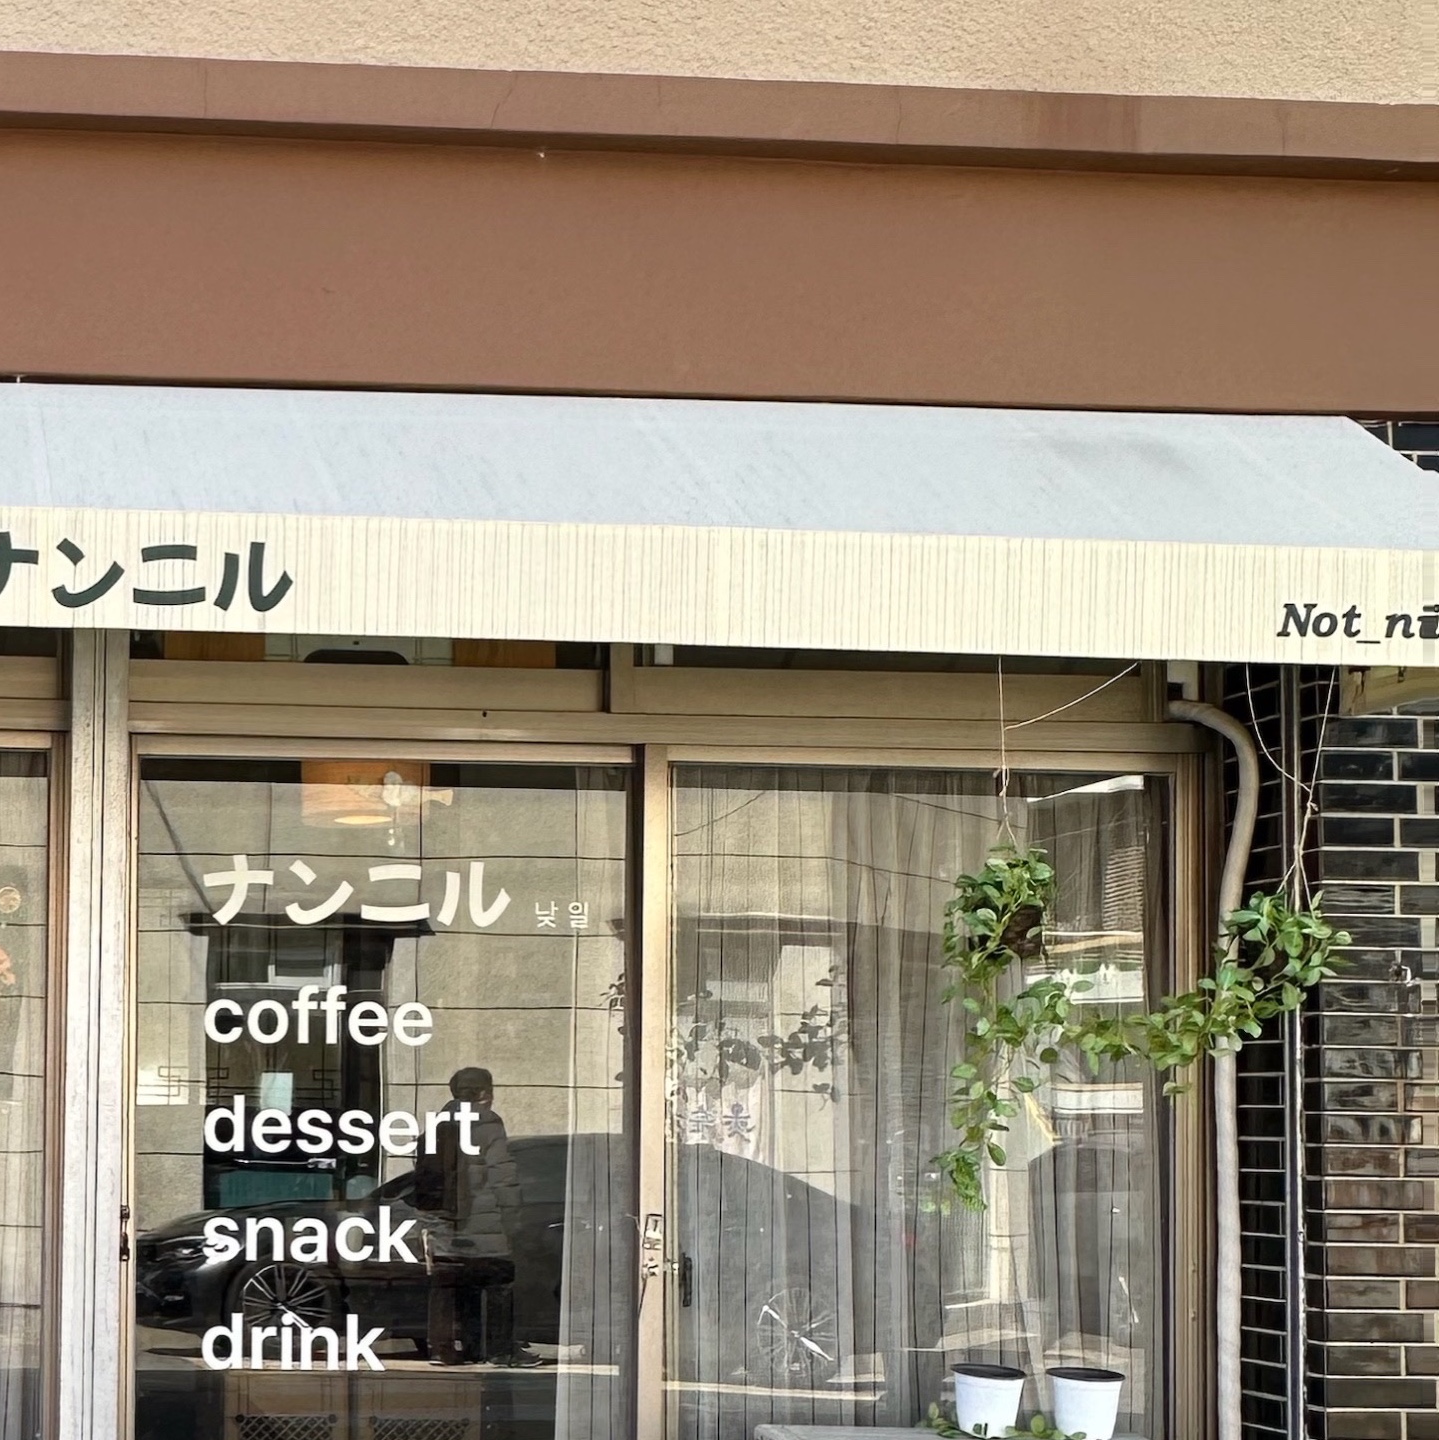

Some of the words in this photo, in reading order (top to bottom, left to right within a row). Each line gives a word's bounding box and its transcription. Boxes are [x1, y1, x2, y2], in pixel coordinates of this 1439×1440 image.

[203, 854, 511, 927] ナンニル
[204, 985, 433, 1046] coffee
[204, 1094, 480, 1156] dessert
[202, 1205, 418, 1263] snack
[201, 1312, 385, 1371] drink
